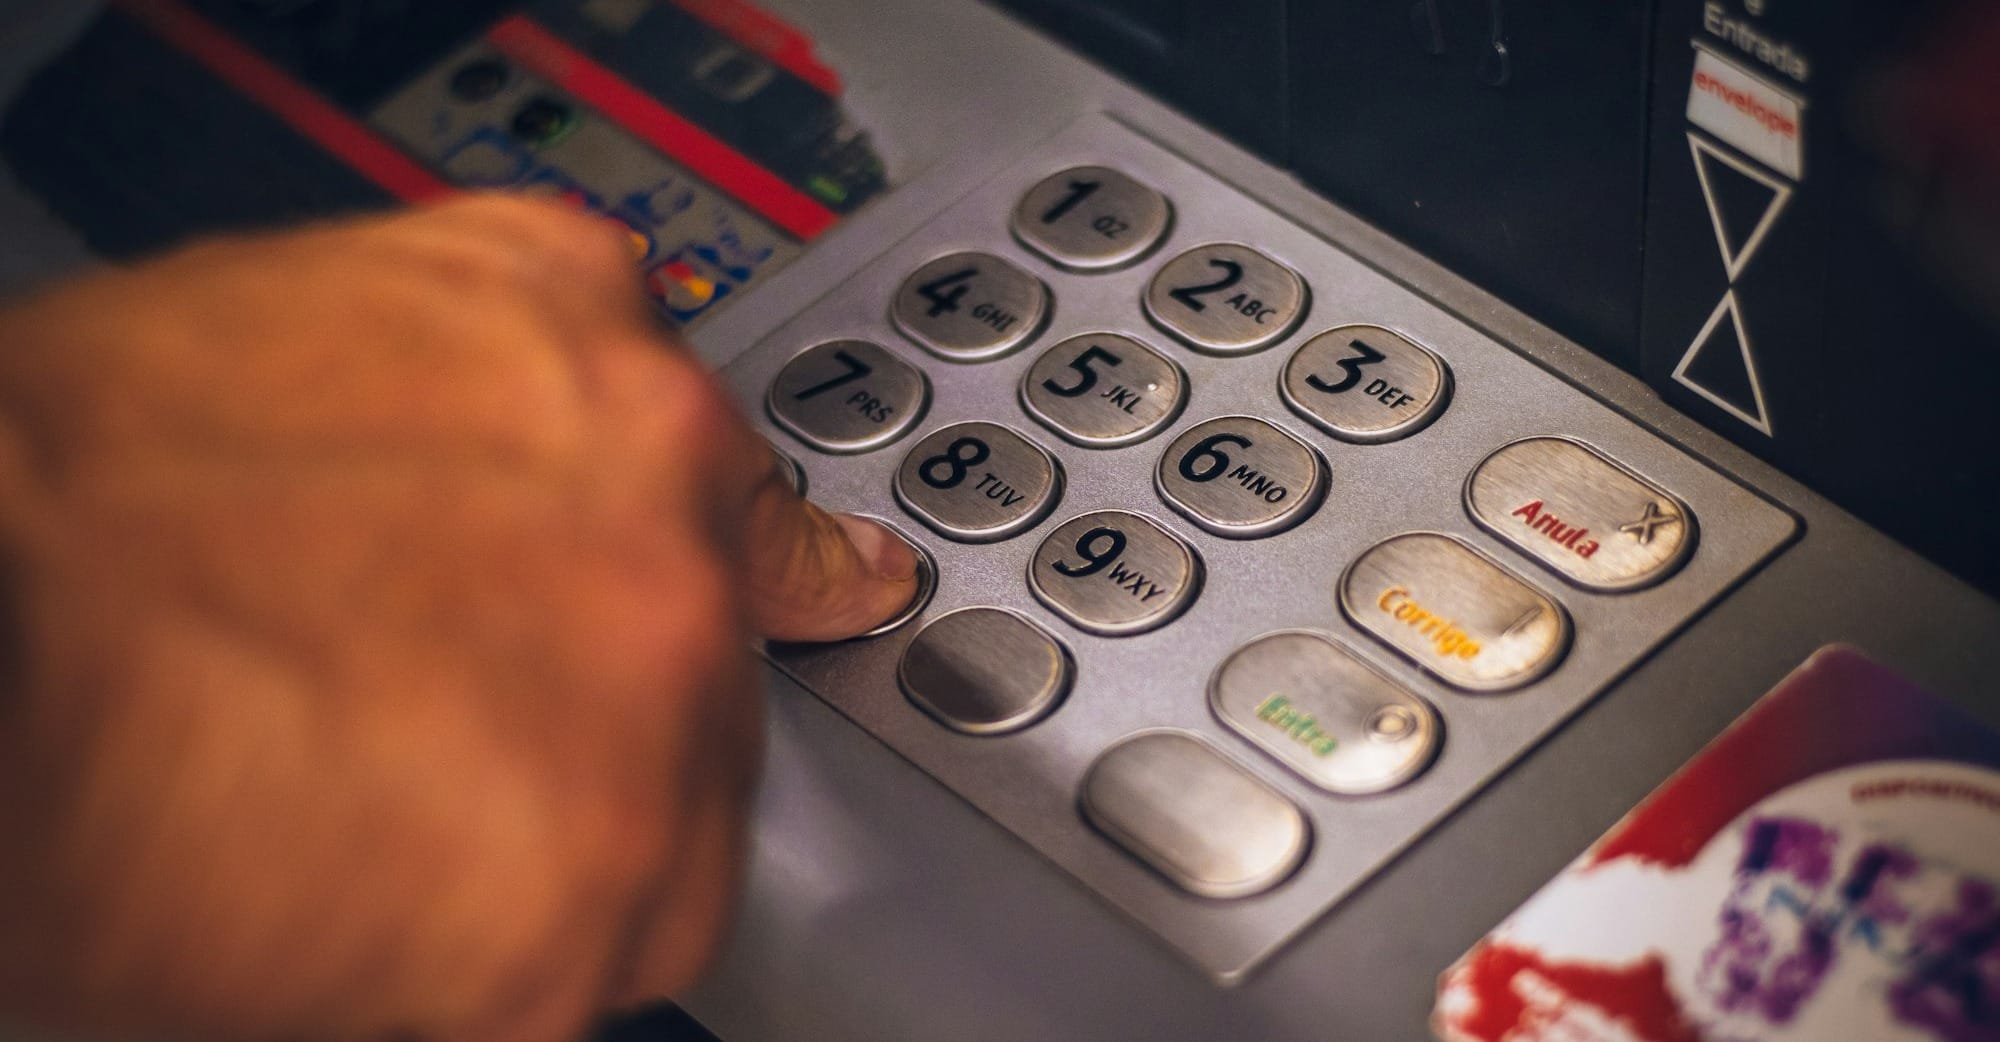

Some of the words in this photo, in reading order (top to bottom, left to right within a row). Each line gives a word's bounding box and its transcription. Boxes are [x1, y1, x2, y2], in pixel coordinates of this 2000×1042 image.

[1703, 1, 1809, 81] Entrada
[1694, 71, 1796, 138] envelope
[1042, 181, 1099, 224] 1
[917, 268, 980, 318] 4
[971, 302, 1018, 333] GHI
[1169, 259, 1243, 313] 2
[1229, 293, 1277, 325] ABC
[795, 350, 873, 401] 7
[846, 391, 893, 424] PRS
[1042, 345, 1122, 398] 5
[1099, 384, 1141, 415] JKL
[1305, 339, 1387, 395] 3
[1364, 379, 1415, 410] DEF
[919, 437, 991, 490] 8
[974, 472, 1025, 508] TUV
[1178, 432, 1255, 483] 6
[1228, 464, 1288, 504] MNO
[1051, 526, 1127, 578] 9
[1108, 560, 1166, 602] WXY
[1511, 500, 1601, 561] Anula
[1379, 588, 1482, 660] Corrige
[1256, 694, 1339, 757] Entra
